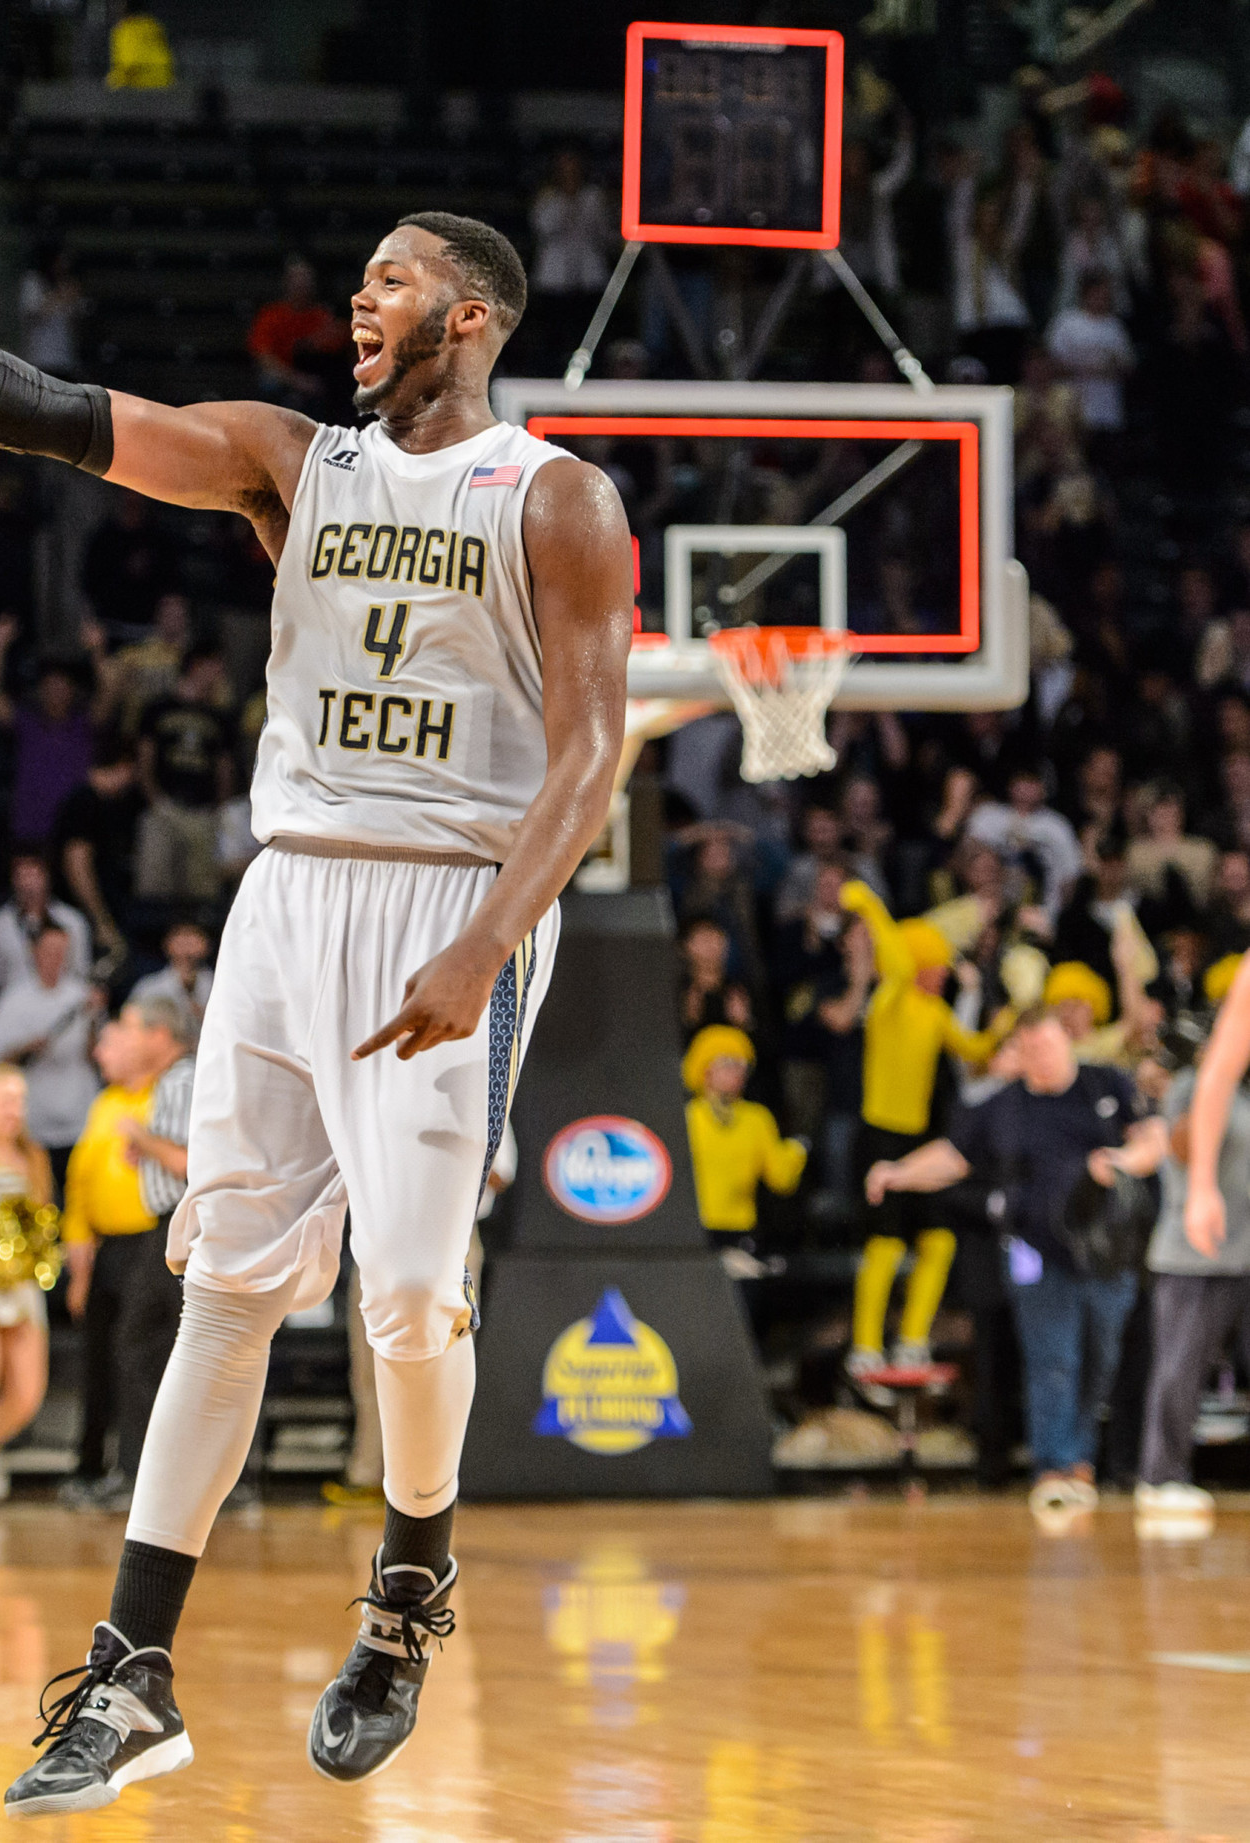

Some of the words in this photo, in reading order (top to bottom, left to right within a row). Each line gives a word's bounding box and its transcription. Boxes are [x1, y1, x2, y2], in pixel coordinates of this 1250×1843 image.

[322, 457, 356, 472] RUSSELL
[311, 523, 488, 600] GEORGIA
[362, 601, 411, 681] 4
[317, 688, 456, 761] TECH
